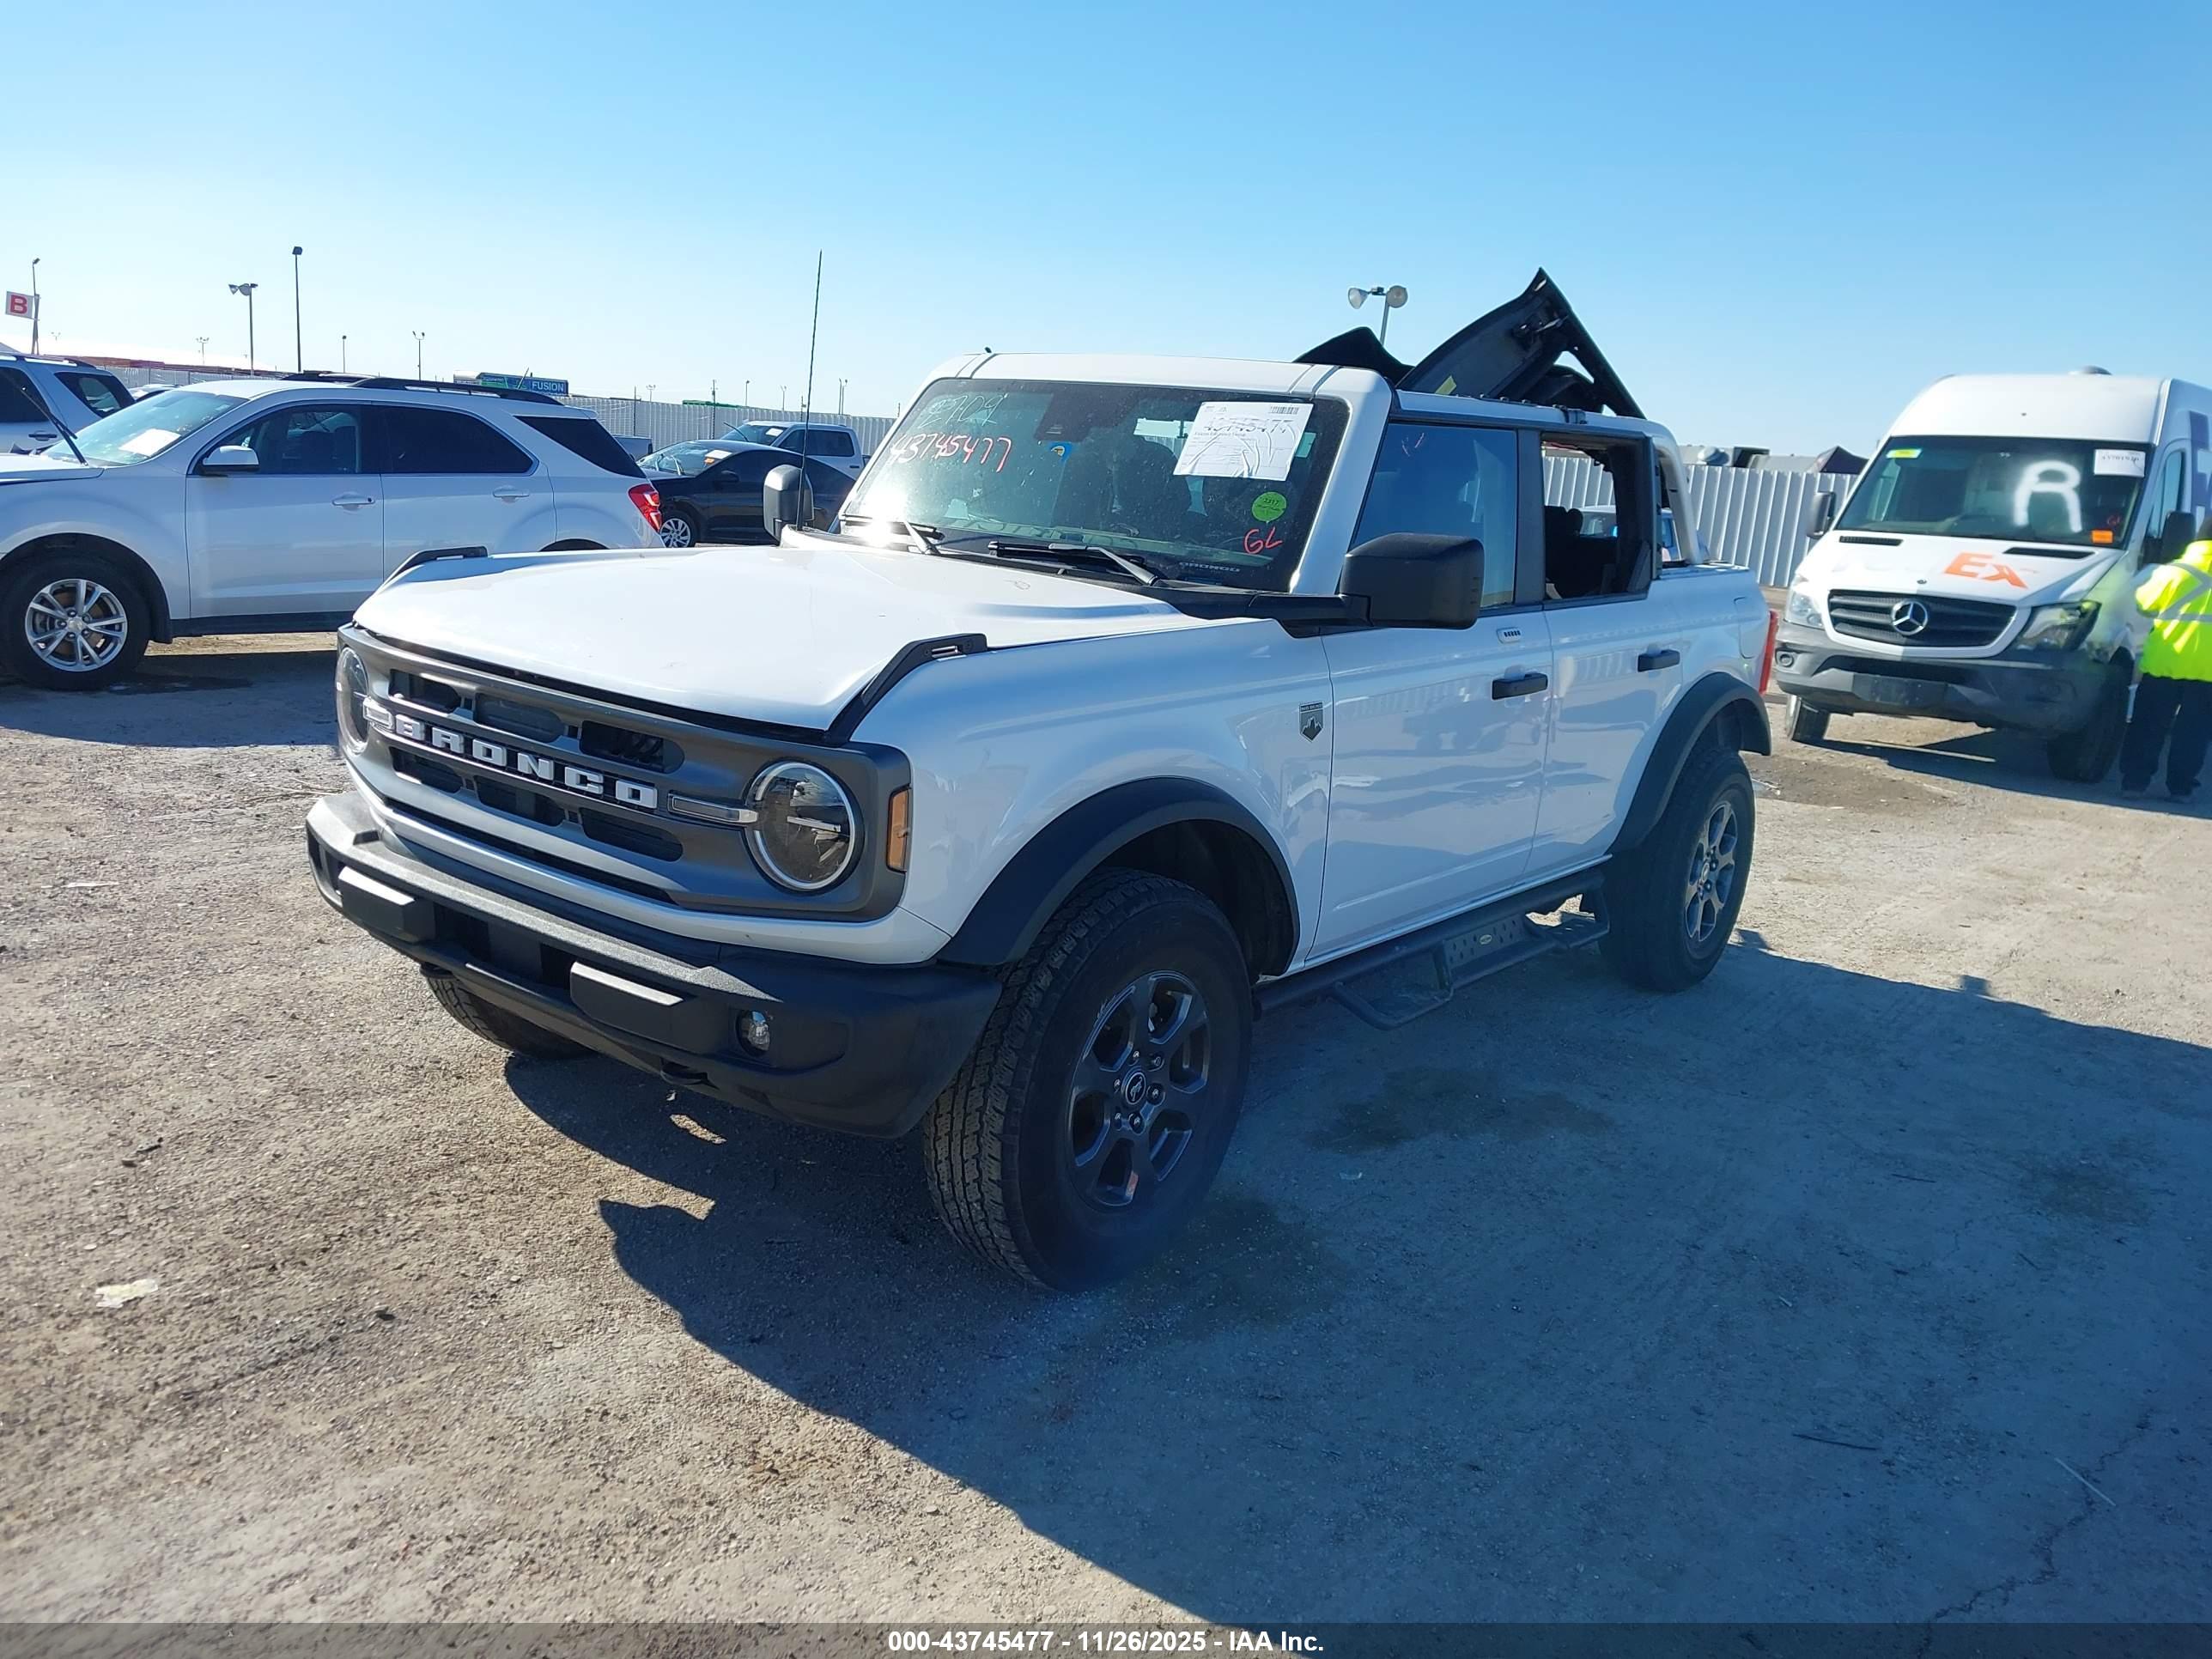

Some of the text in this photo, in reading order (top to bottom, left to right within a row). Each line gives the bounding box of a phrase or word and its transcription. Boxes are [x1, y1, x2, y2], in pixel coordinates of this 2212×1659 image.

[10, 295, 27, 314] B
[532, 380, 564, 392] FUSION
[2013, 460, 2082, 533] R
[395, 713, 659, 810] BRONCO
